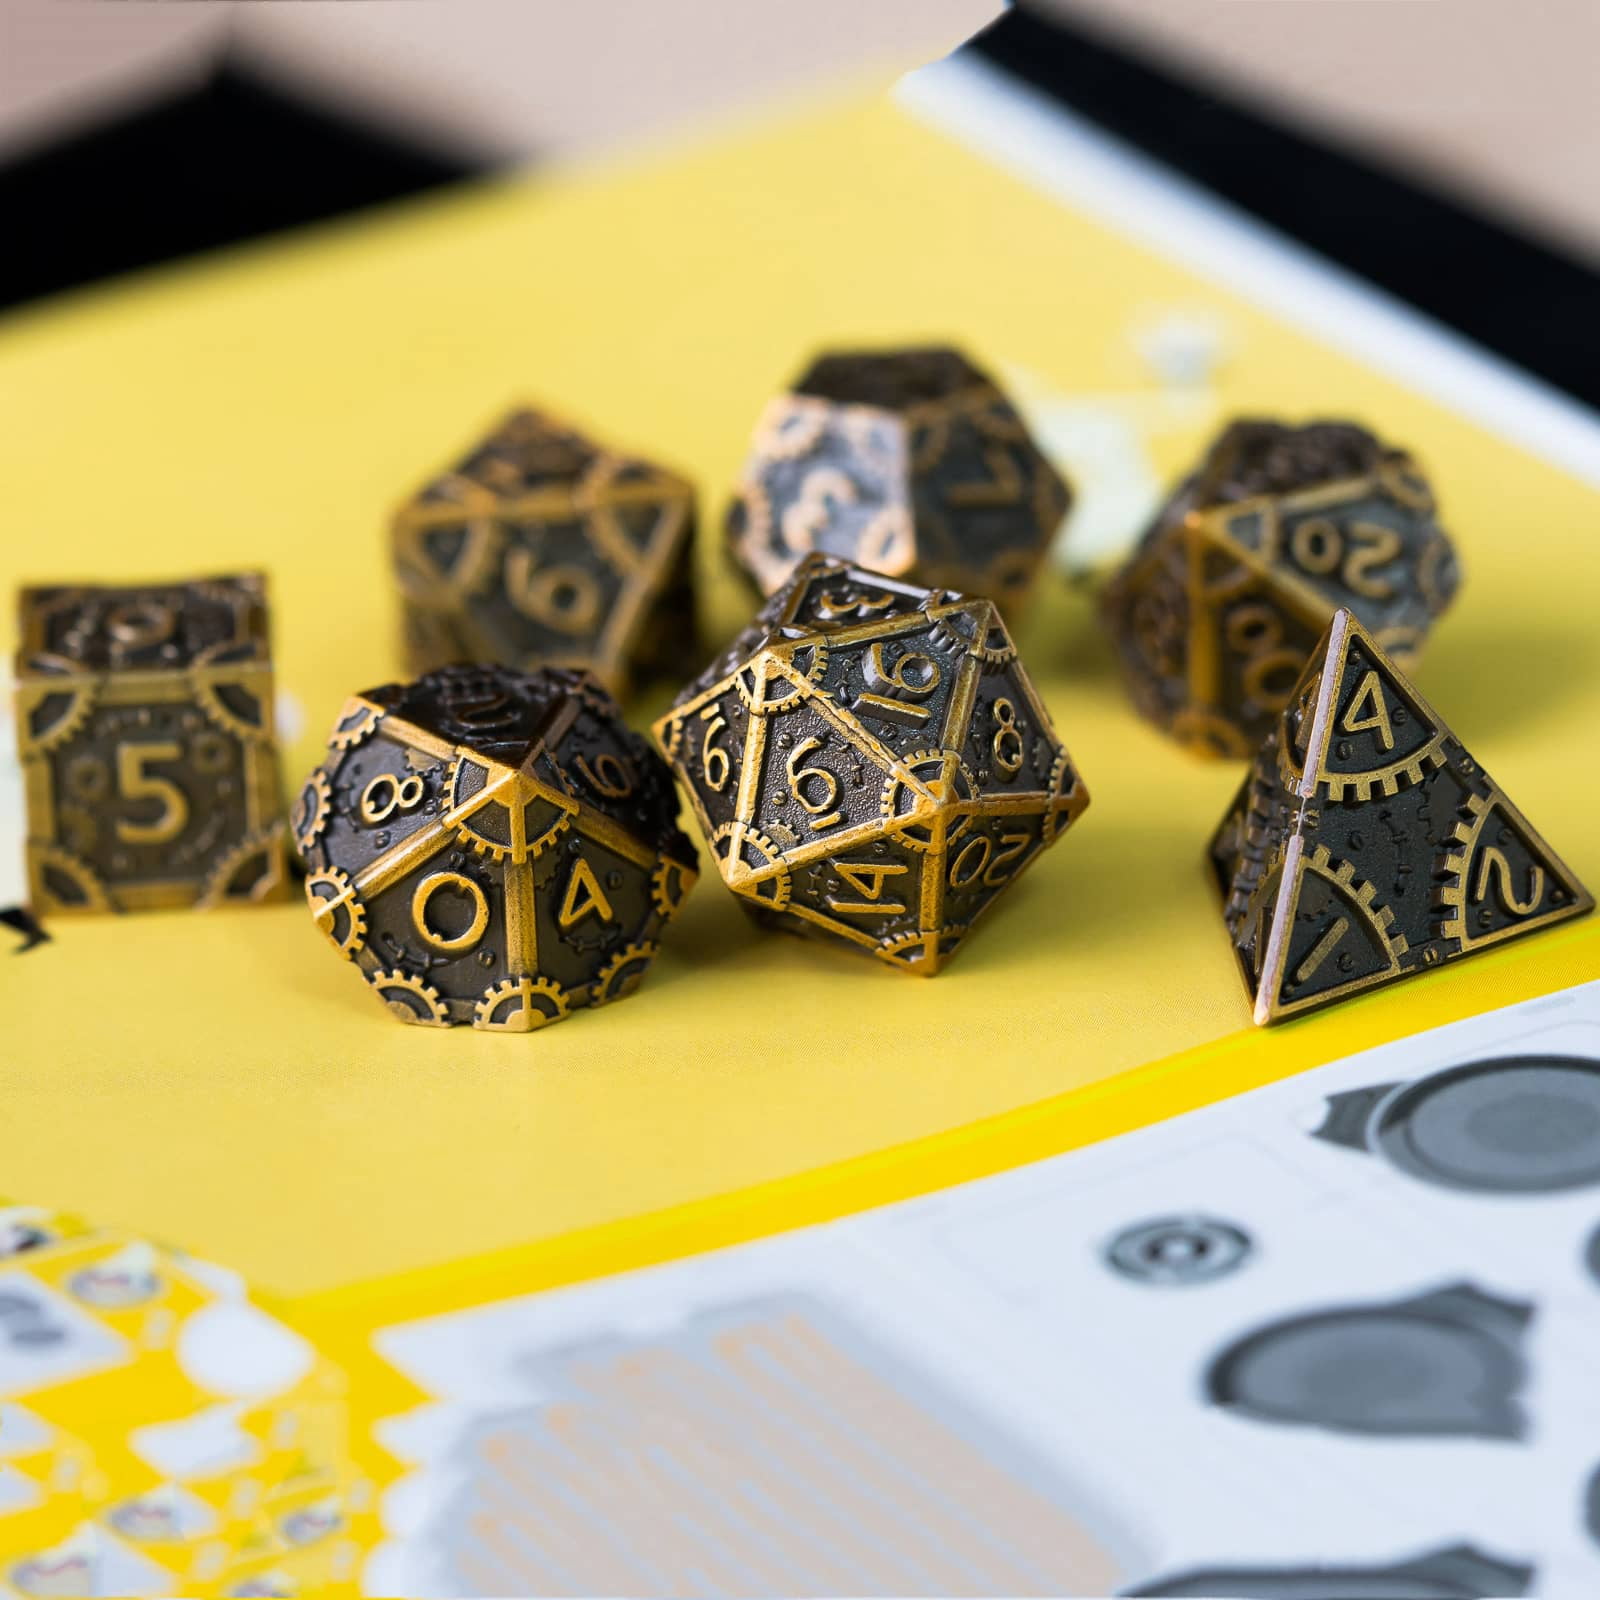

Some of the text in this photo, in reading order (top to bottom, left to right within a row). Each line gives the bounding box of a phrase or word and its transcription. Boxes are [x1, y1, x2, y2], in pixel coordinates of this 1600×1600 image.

[992, 697, 1024, 773] 8
[1341, 670, 1396, 750] 4
[116, 742, 188, 843] 5
[360, 773, 425, 824] 8
[831, 861, 909, 914] 14
[948, 834, 1031, 888] 20
[1476, 846, 1544, 915] 2
